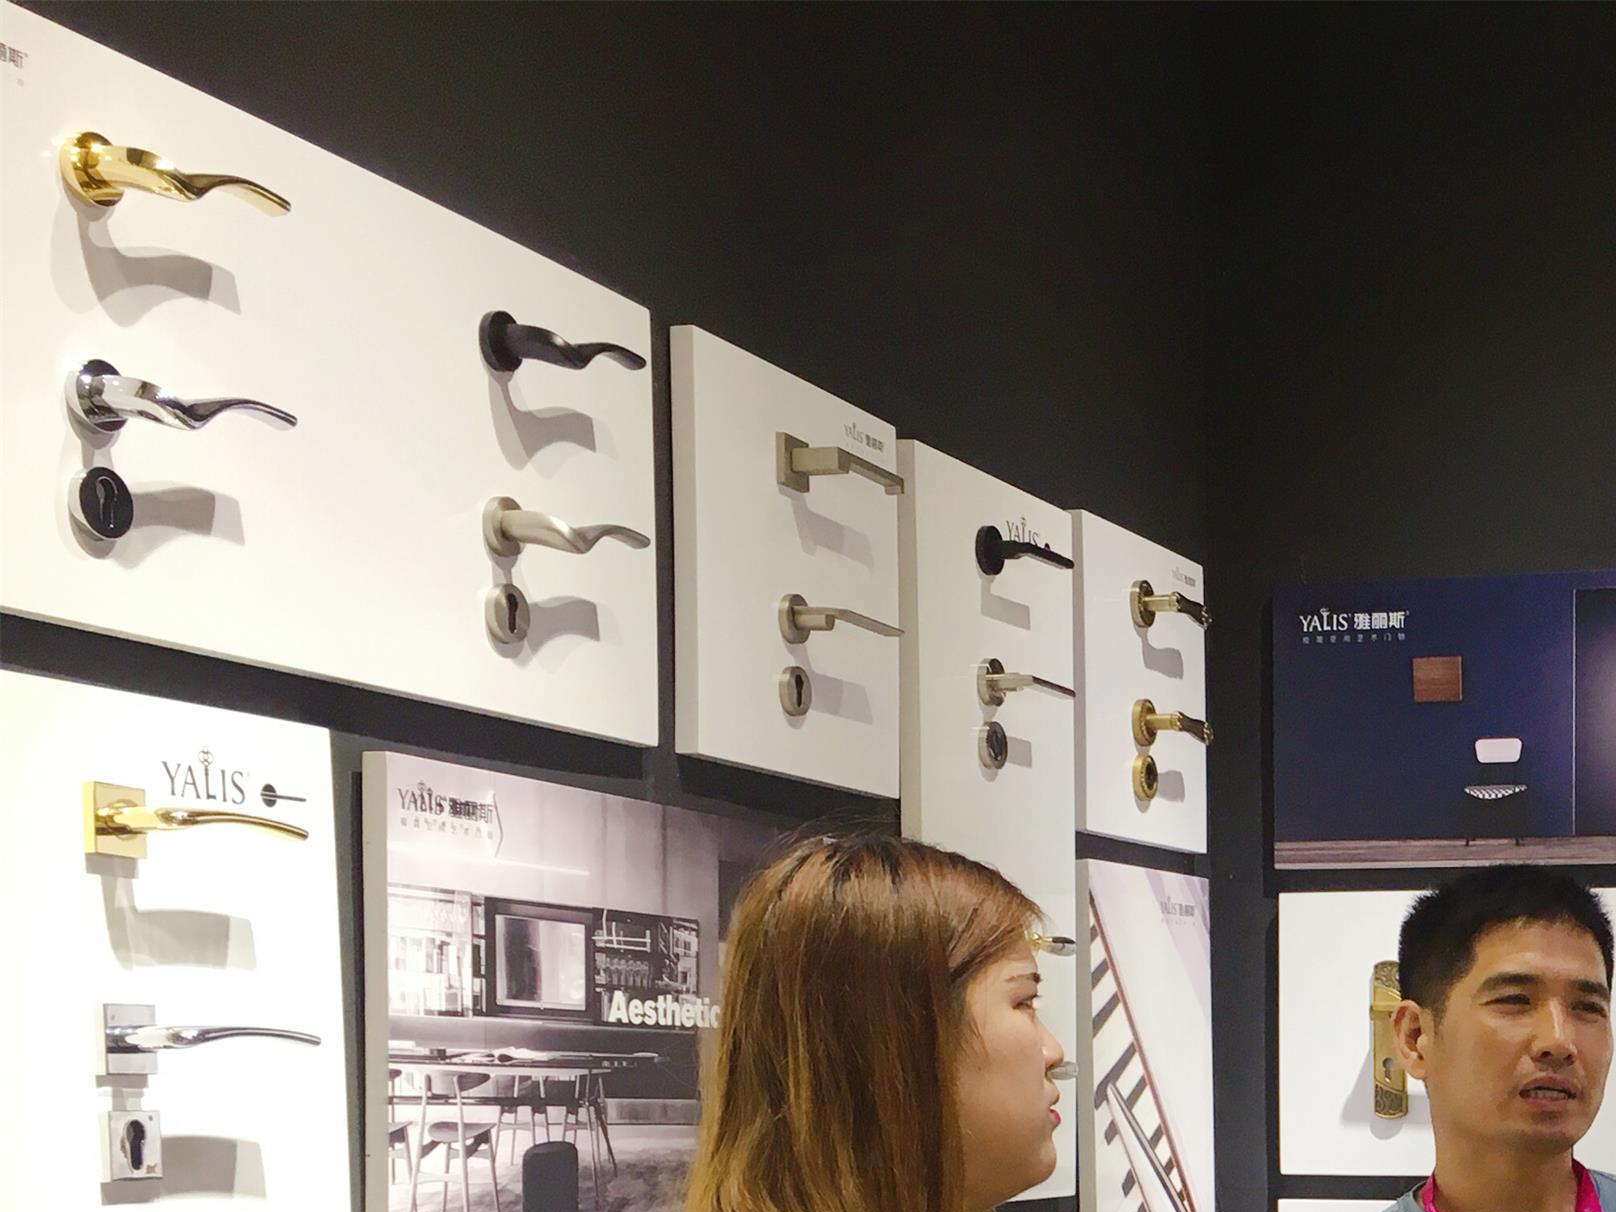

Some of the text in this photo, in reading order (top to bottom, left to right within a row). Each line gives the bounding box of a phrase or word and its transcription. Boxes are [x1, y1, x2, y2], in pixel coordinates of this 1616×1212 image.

[1299, 608, 1406, 632] YALIS 雅丽斯
[161, 746, 246, 805] YALIS
